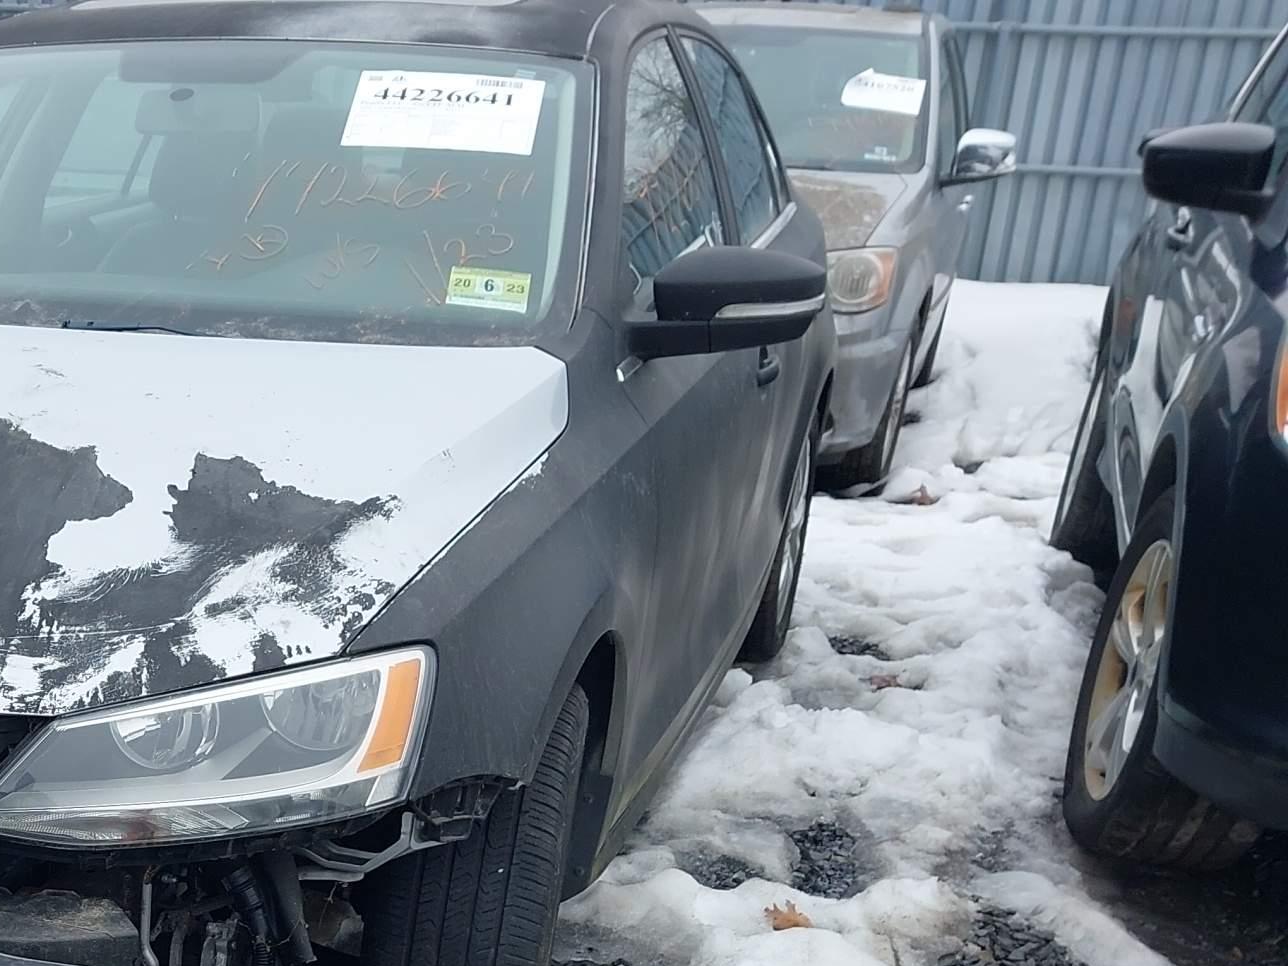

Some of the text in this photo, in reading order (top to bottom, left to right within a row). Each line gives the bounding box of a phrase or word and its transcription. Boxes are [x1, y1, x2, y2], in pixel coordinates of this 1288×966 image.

[373, 87, 514, 106] 44226641
[454, 278, 525, 294] 20 6 23
